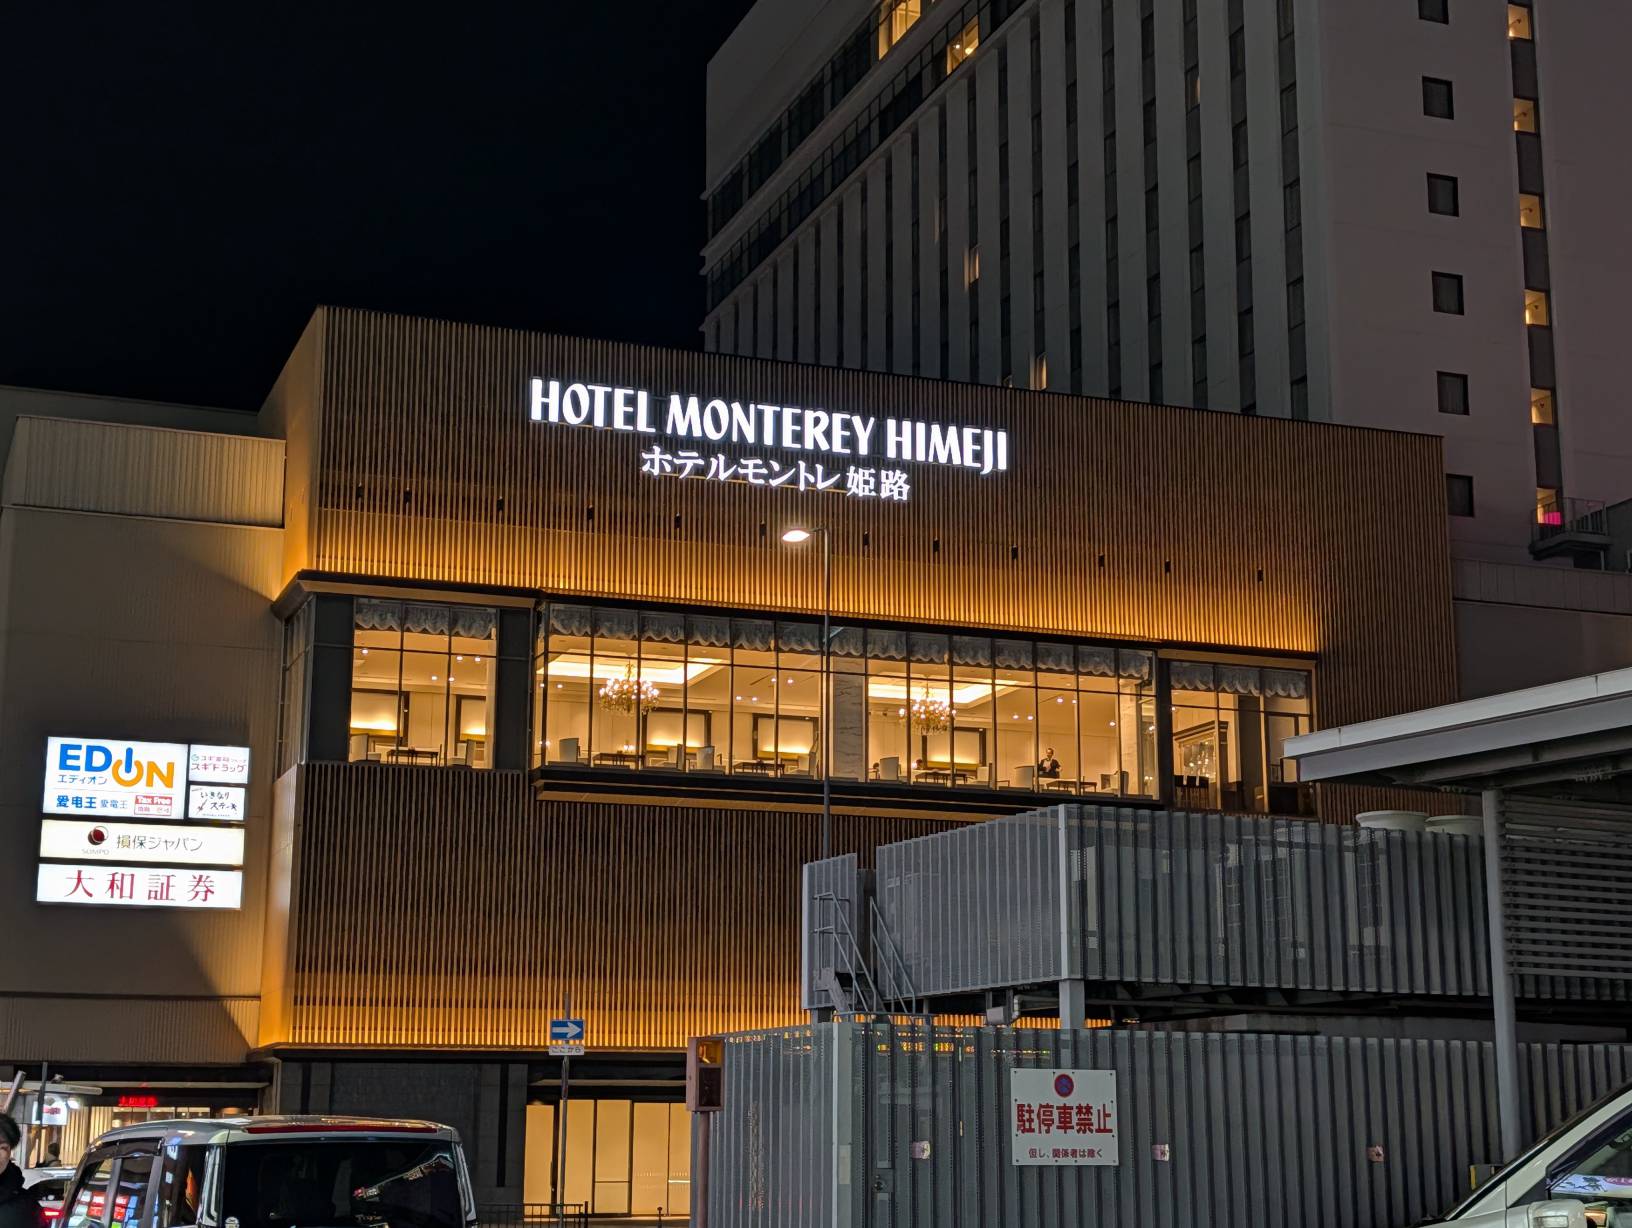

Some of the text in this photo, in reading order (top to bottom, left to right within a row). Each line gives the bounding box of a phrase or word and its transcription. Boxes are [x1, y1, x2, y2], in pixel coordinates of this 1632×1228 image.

[530, 377, 1008, 475] HOTEL MONTEREY HIMEJI
[640, 445, 911, 501] ホテルモントレ姫路
[58, 743, 175, 788] EDION
[191, 762, 247, 773] スギドラッグ
[57, 774, 108, 785] エディオン
[137, 795, 171, 805] Tax Free
[200, 791, 230, 800] いきなり
[210, 801, 238, 811] ステーキ
[116, 834, 203, 852] 損保ジャパン
[64, 869, 215, 902] 大和証券
[1016, 1102, 1113, 1134] 駐停車禁止
[1028, 1148, 1104, 1159] 但し、関係者は除く
